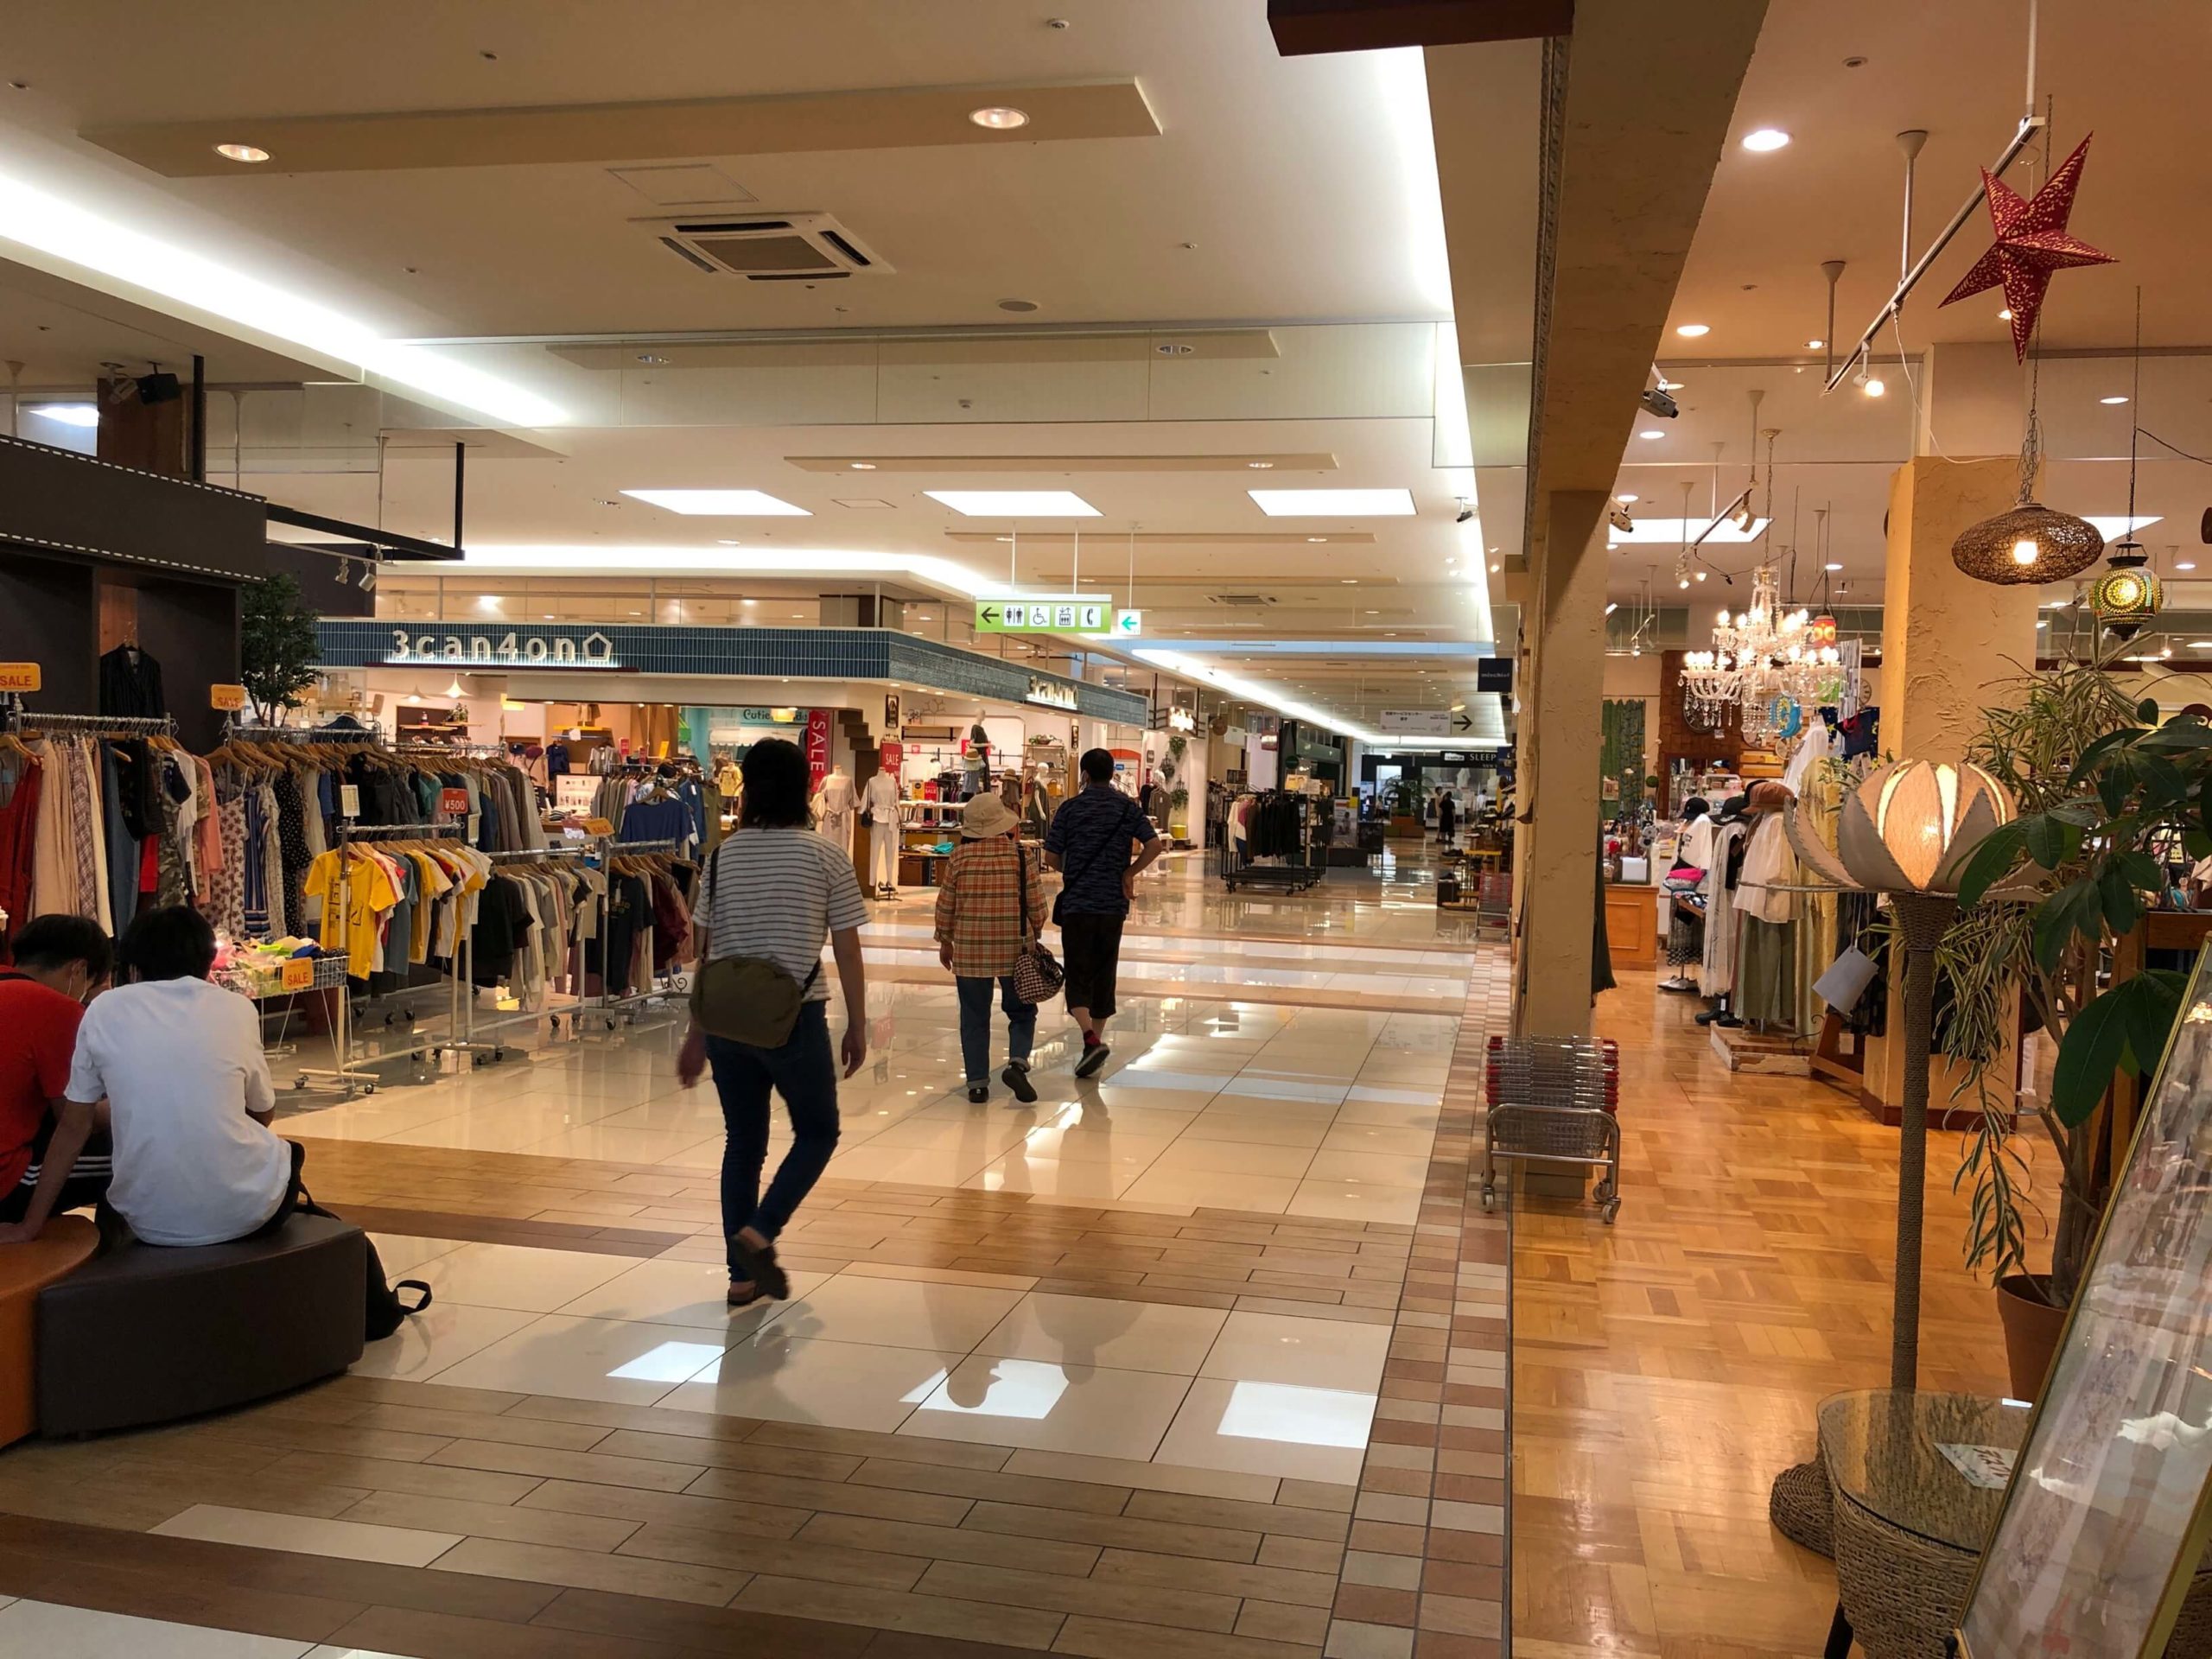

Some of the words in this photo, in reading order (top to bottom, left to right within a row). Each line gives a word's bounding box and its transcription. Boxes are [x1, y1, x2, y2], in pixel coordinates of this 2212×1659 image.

[392, 630, 575, 661] 3can4on
[0, 676, 32, 686] SALE
[218, 696, 239, 708] SALE
[810, 721, 826, 772] SALE
[886, 753, 899, 766] SALE
[1470, 753, 1497, 761] SLEEP
[445, 800, 465, 810] ¥500
[288, 972, 308, 985] SALE
